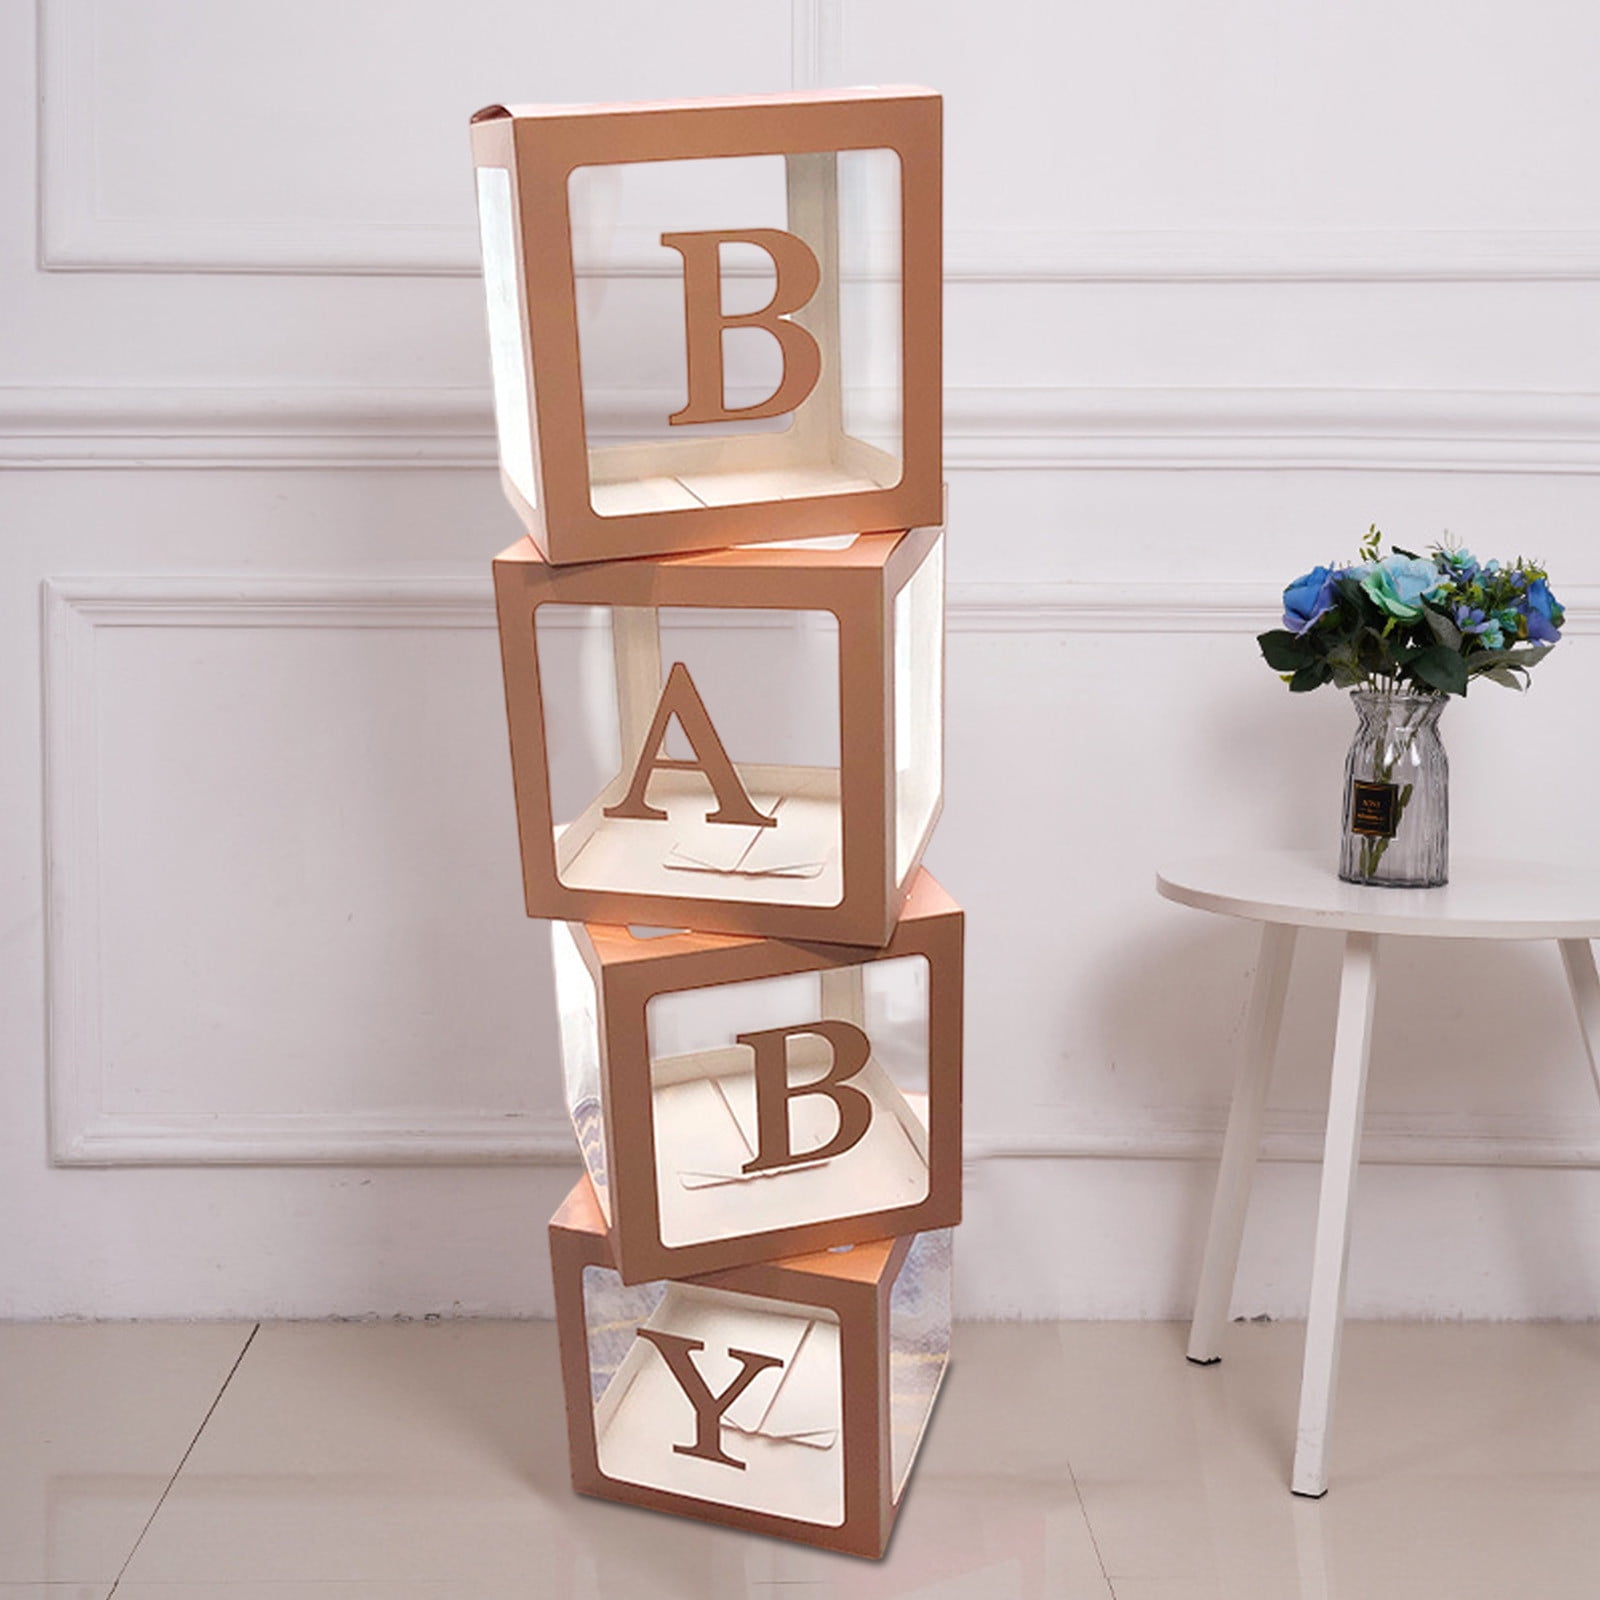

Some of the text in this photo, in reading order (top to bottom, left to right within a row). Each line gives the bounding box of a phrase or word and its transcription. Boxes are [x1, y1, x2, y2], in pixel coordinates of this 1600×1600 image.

[661, 228, 821, 426] B
[603, 662, 777, 828] A
[736, 1019, 873, 1174] B
[636, 1327, 784, 1471] Y
